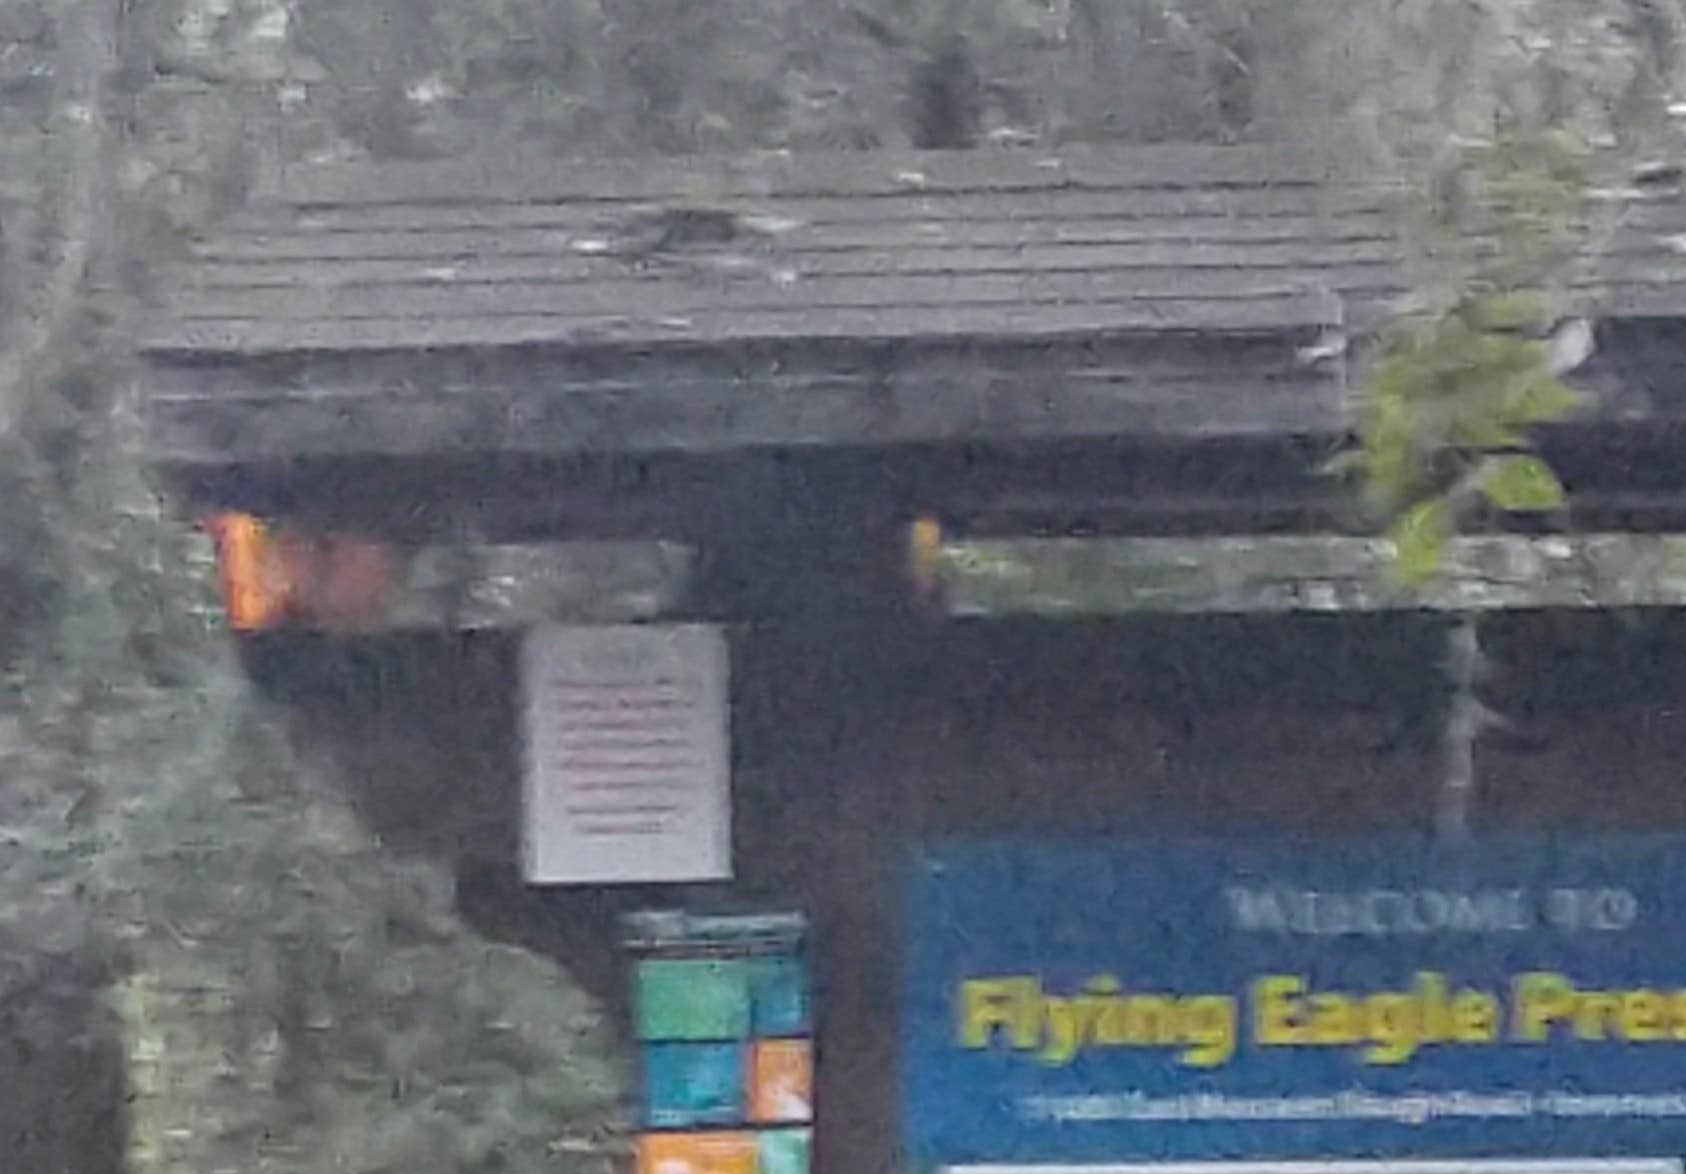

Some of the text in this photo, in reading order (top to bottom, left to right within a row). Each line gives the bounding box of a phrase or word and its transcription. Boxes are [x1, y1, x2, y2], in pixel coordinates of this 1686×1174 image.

[1227, 887, 1639, 934] WELCOME TO
[956, 973, 1239, 1066] Flying
[1252, 969, 1498, 1064] Eagle
